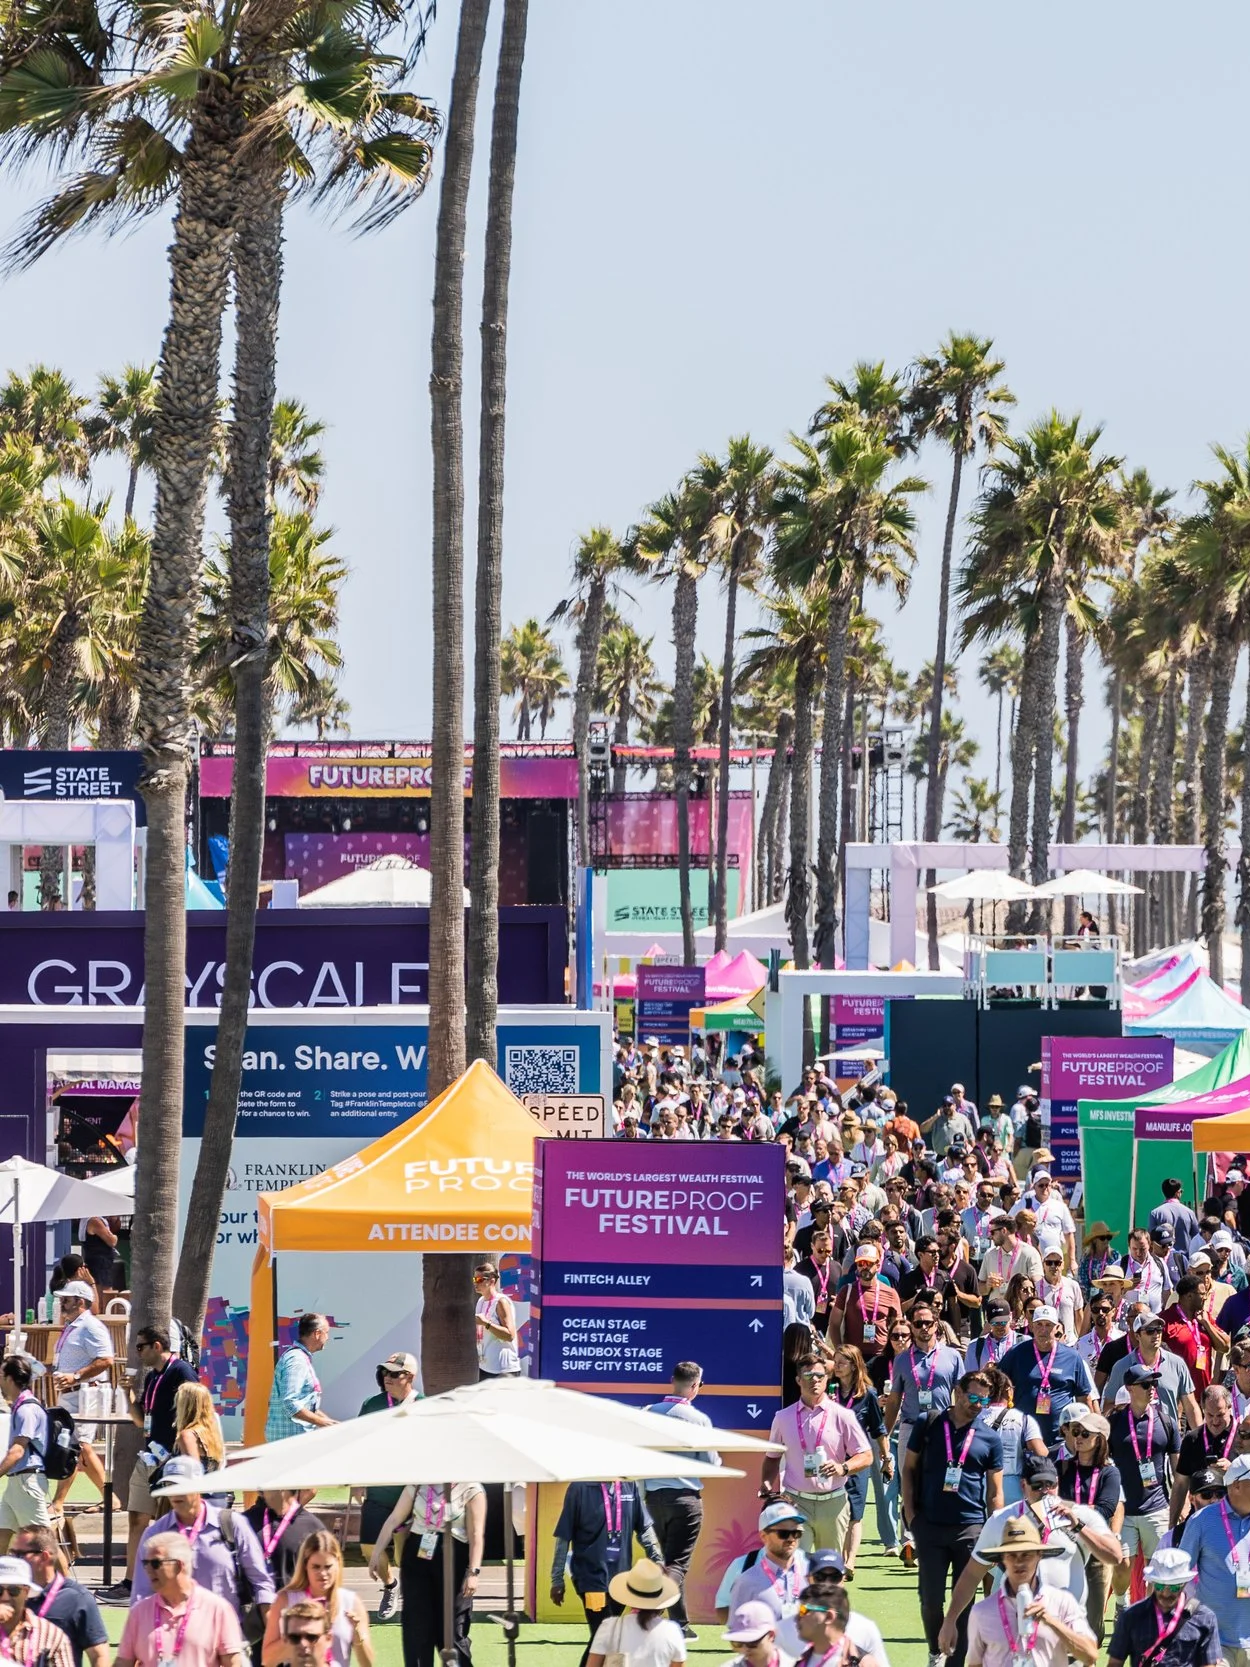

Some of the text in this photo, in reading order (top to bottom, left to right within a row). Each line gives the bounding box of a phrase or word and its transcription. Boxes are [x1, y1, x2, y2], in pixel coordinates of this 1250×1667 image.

[56, 768, 110, 782] STATE
[56, 782, 122, 796] STREET
[632, 906, 667, 916] STATE
[294, 1045, 388, 1070] Share.
[1062, 1062, 1164, 1073] FUTUREPROOF
[98, 1080, 142, 1090] MANAG
[1079, 1074, 1146, 1086] FESTIVAL
[240, 1090, 253, 1098] the
[267, 1090, 286, 1098] code
[287, 1090, 301, 1098] and
[314, 1090, 321, 1100] 2
[330, 1090, 351, 1098] Strike
[358, 1092, 376, 1100] pose
[377, 1090, 391, 1098] and
[392, 1092, 408, 1100] post
[330, 1100, 343, 1109] Tag
[344, 1100, 416, 1109] #FranklinTempleton
[378, 1111, 398, 1119] entry.
[530, 1106, 599, 1121] SPEED
[1090, 1110, 1104, 1120] MFS
[1146, 1122, 1180, 1132] MANULIFE
[245, 1164, 327, 1176] FRANKLIN
[566, 1171, 764, 1184] THE WORLD'S LARGEST WEALTH FESTIVAL
[565, 1188, 764, 1211] FUTUREPROOF
[599, 1214, 729, 1236] FESTIVAL
[368, 1223, 479, 1241] ATTENDEE
[564, 1274, 651, 1286] FINTECH ALLEY
[562, 1318, 647, 1330] OCEAN STAGE
[563, 1333, 629, 1344] PCH STAGE
[562, 1346, 663, 1358] SANDBOX STAGE
[562, 1360, 663, 1372] SURF CITY STAGE
